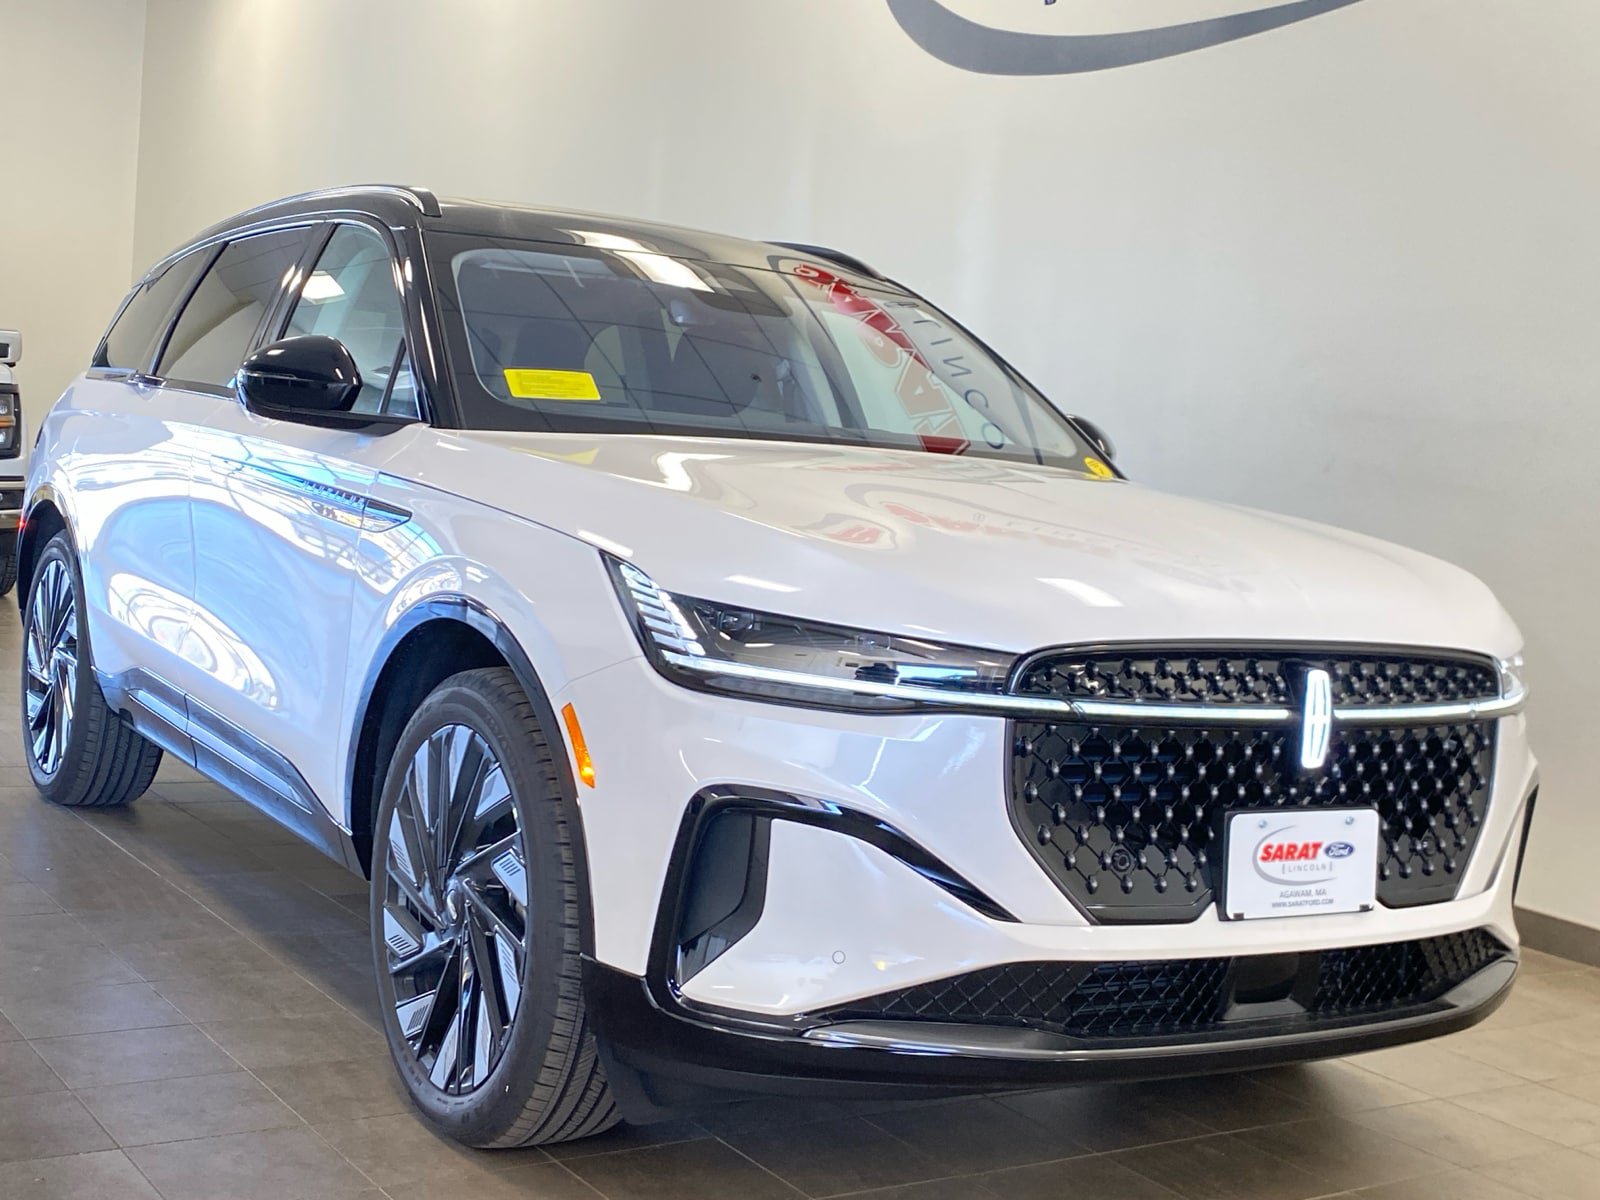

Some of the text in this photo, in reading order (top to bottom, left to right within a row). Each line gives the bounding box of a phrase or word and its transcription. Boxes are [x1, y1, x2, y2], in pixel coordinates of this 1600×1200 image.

[1260, 842, 1322, 862] SARAT
[1327, 843, 1351, 857] Ford
[1288, 864, 1326, 873] LINCOLN
[1315, 888, 1327, 896] MA
